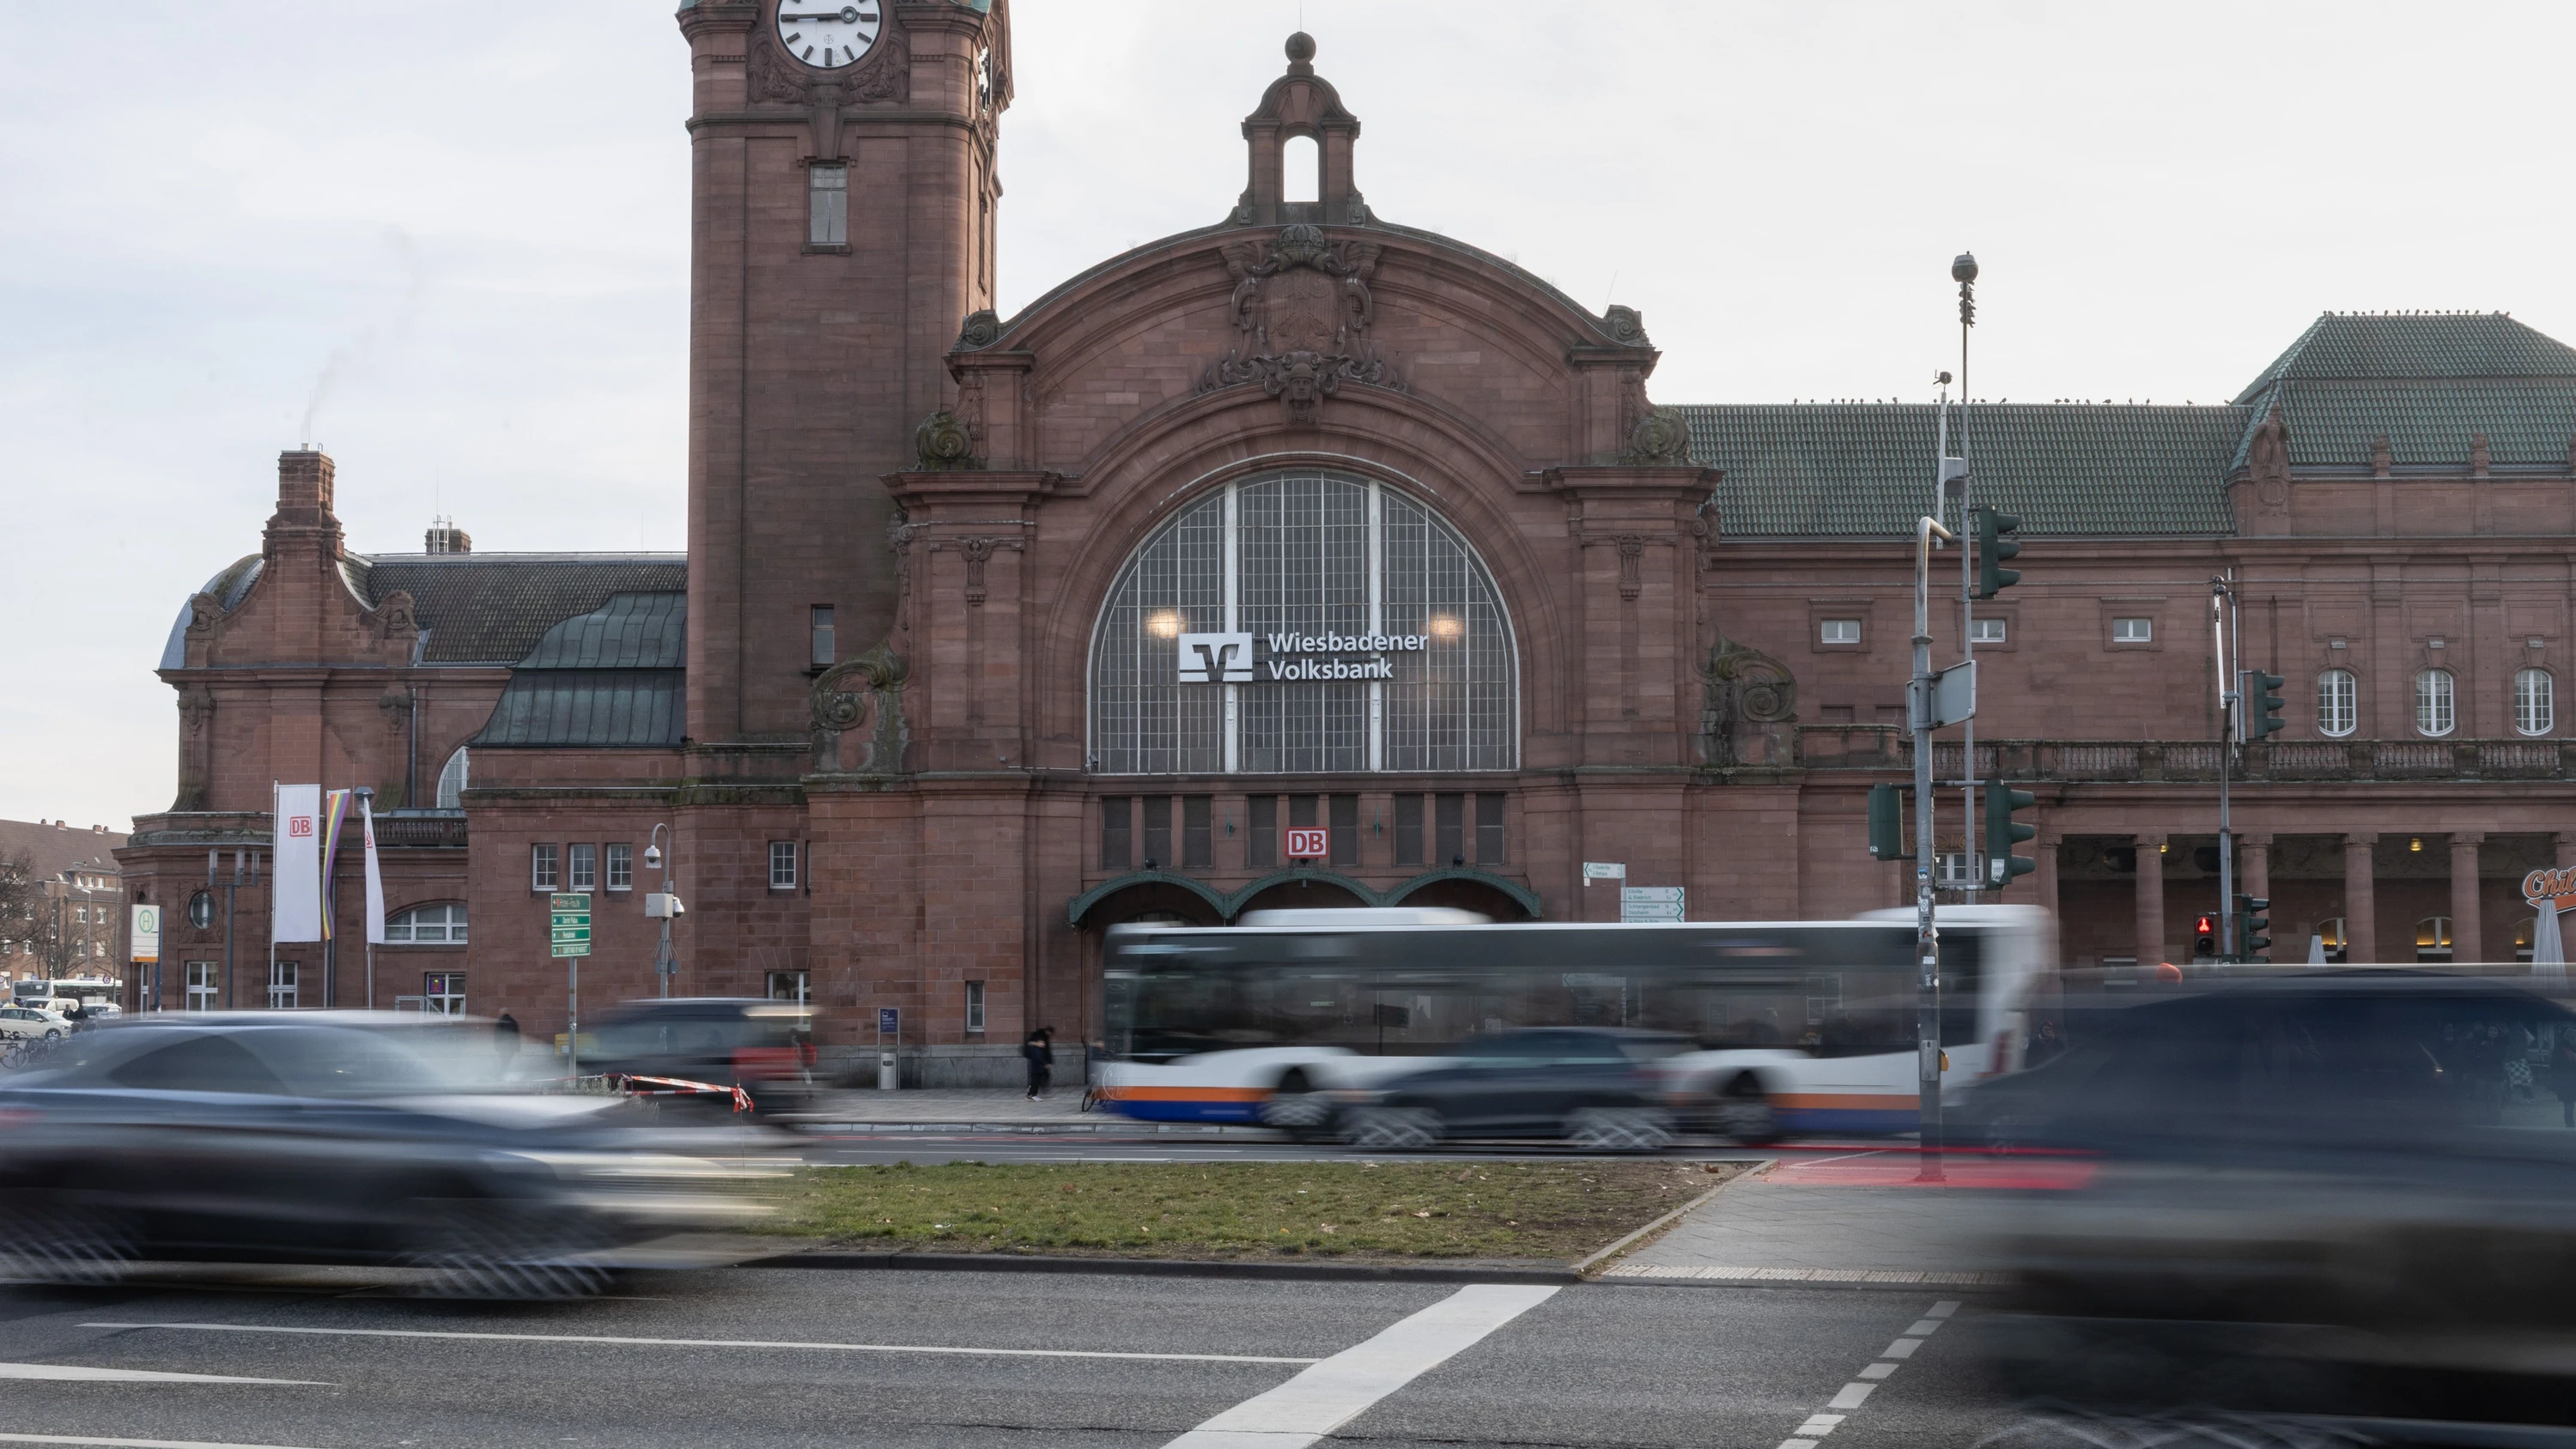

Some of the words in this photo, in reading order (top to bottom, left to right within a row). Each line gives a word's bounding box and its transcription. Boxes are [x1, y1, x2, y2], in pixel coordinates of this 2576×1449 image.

[1267, 630, 1428, 652] Wiesbadener
[1267, 658, 1393, 680] Volksbank
[292, 820, 311, 834] DB
[1291, 833, 1324, 852] DB
